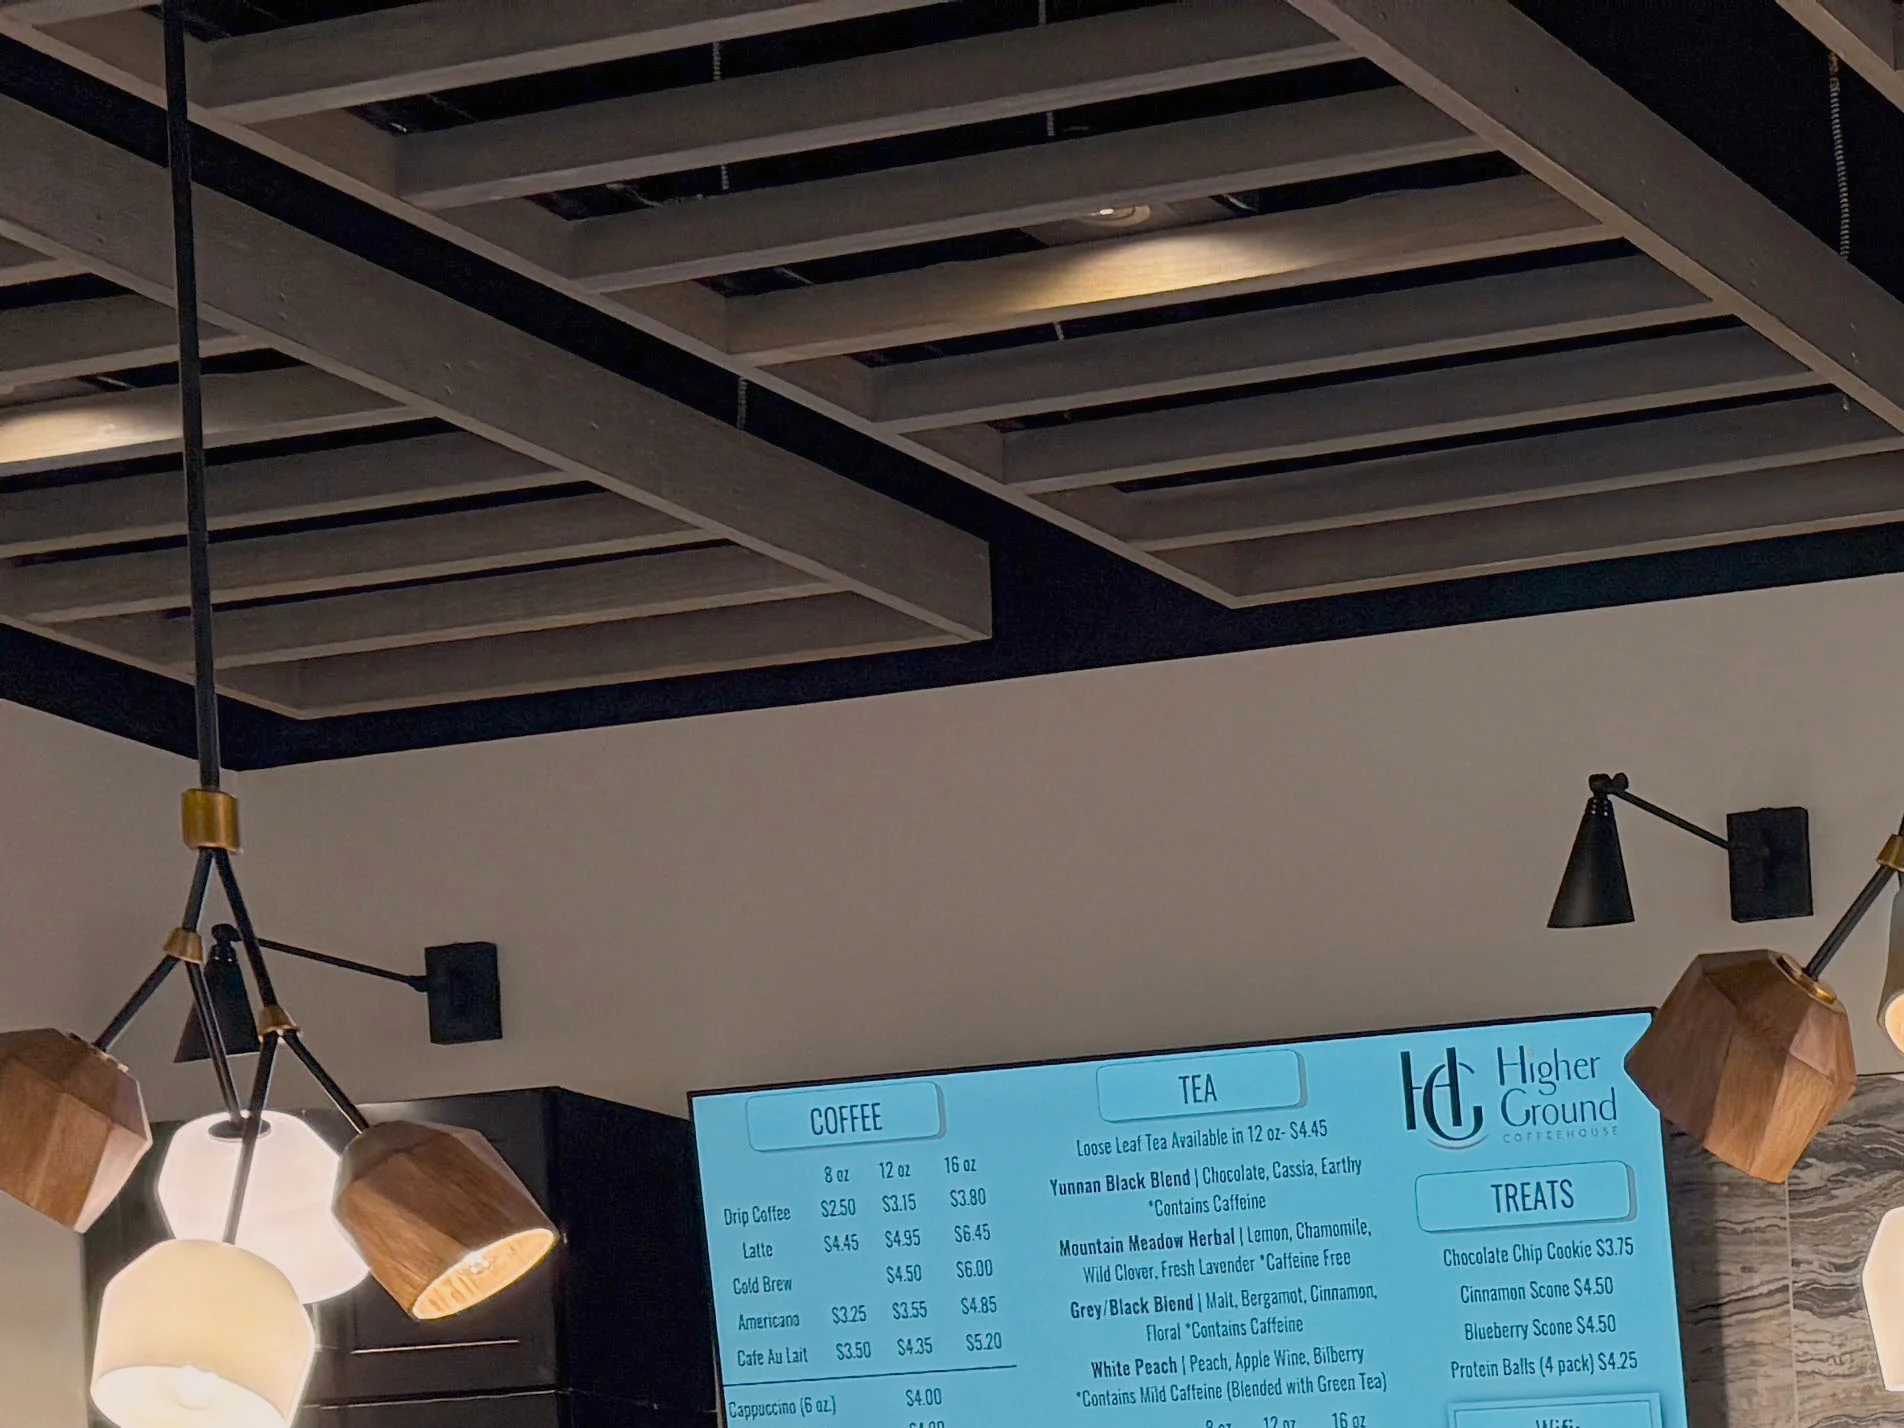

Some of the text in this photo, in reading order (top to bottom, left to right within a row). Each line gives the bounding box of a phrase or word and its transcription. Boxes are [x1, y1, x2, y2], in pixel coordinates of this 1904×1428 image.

[1497, 1045, 1601, 1096] Higher
[1177, 1073, 1218, 1105] TEA
[810, 1102, 883, 1136] COFFEE
[1500, 1086, 1618, 1127] Ground
[1076, 1118, 1328, 1157] Loose Leaf Tea Available in 12 oz- $4.45
[1502, 1125, 1619, 1145] COFFEEHOUSE
[824, 1155, 977, 1184] 8 oz 12 oz 16 oz
[1049, 1156, 1362, 1196] Yunnan Black Blend Chocolate, Cassia, Earthy
[723, 1187, 986, 1228] Drip Coffee $2.50 $3.15 $3.80
[1212, 1193, 1266, 1213] Caffeine
[1490, 1178, 1574, 1213] TREATS
[742, 1223, 991, 1259] Latte $4.45 $4.95 $6.45
[1059, 1217, 1372, 1257] Mountain Meadow Herbal Lemon, Chamomile,
[1443, 1236, 1634, 1267] Chocolate Chip Cookie $3.75
[732, 1258, 993, 1295] Cold Brew $4.50 $6.00
[1082, 1264, 1111, 1283] Wild
[1114, 1263, 1159, 1281] Clover,
[1160, 1258, 1195, 1278] Fresh
[1198, 1255, 1255, 1276] Lavender
[1322, 1248, 1351, 1267] Free
[1070, 1284, 1378, 1321] Grey/Black Blend Malt, Bergamot, Cinnamon,
[1460, 1275, 1614, 1304] Cinnamon Scone $4.50
[738, 1295, 997, 1331] Americano $3.25 $3.55 $4.85
[1145, 1322, 1181, 1342] Floral
[1249, 1316, 1303, 1335] Caffeine
[1464, 1313, 1616, 1341] Blueberry Scone $4.50
[737, 1331, 1002, 1367] Cafe Au Lait $3.50 $4.35 $5.20
[1090, 1346, 1364, 1379] White Peach Peach, Apple Wine, Bilberry
[1450, 1350, 1638, 1379] Protein Balls (4 pack) $4.25
[1139, 1385, 1167, 1403] Mild
[1169, 1383, 1223, 1402] Caffeine
[1226, 1377, 1283, 1402] (Blended
[1286, 1375, 1314, 1394] with
[1317, 1374, 1356, 1393] Green
[1358, 1371, 1387, 1393] Tea)
[1352, 1415, 1366, 1428] oz
